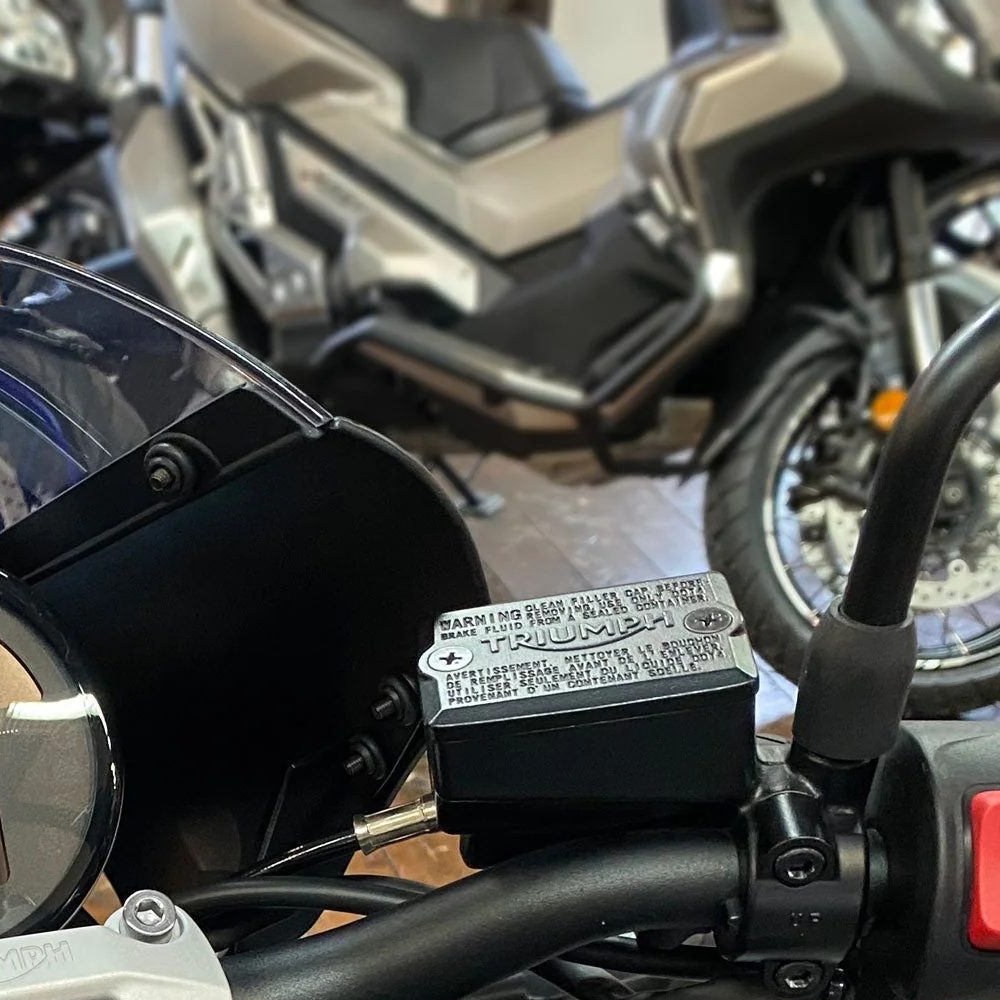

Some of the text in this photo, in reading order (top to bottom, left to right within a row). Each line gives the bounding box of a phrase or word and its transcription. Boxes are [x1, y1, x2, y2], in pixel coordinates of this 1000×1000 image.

[525, 600, 564, 611] CLEAN
[571, 592, 620, 604] FILLER
[625, 586, 648, 597] CAP
[600, 599, 623, 609] USE
[632, 593, 662, 603] ONLY
[439, 610, 522, 631] WARNING
[440, 629, 477, 640] BRAKE
[485, 622, 523, 633] FLUID
[529, 617, 561, 626] FROM
[567, 613, 575, 622] A
[583, 607, 628, 618] SEALED
[481, 611, 675, 653] TRIUMPH
[565, 648, 629, 663] NETTOYER
[638, 644, 653, 653] LE
[446, 681, 462, 690] DE
[472, 667, 559, 685] REMPLISSAGE
[568, 660, 609, 671] AVANT
[619, 655, 634, 664] DE
[447, 683, 511, 697] UTILISER
[519, 670, 592, 687] SEULEMENT
[600, 667, 617, 676] DU
[448, 689, 519, 705] PROVENANT
[544, 683, 560, 692] UN
[567, 672, 639, 688] CONTENANT
